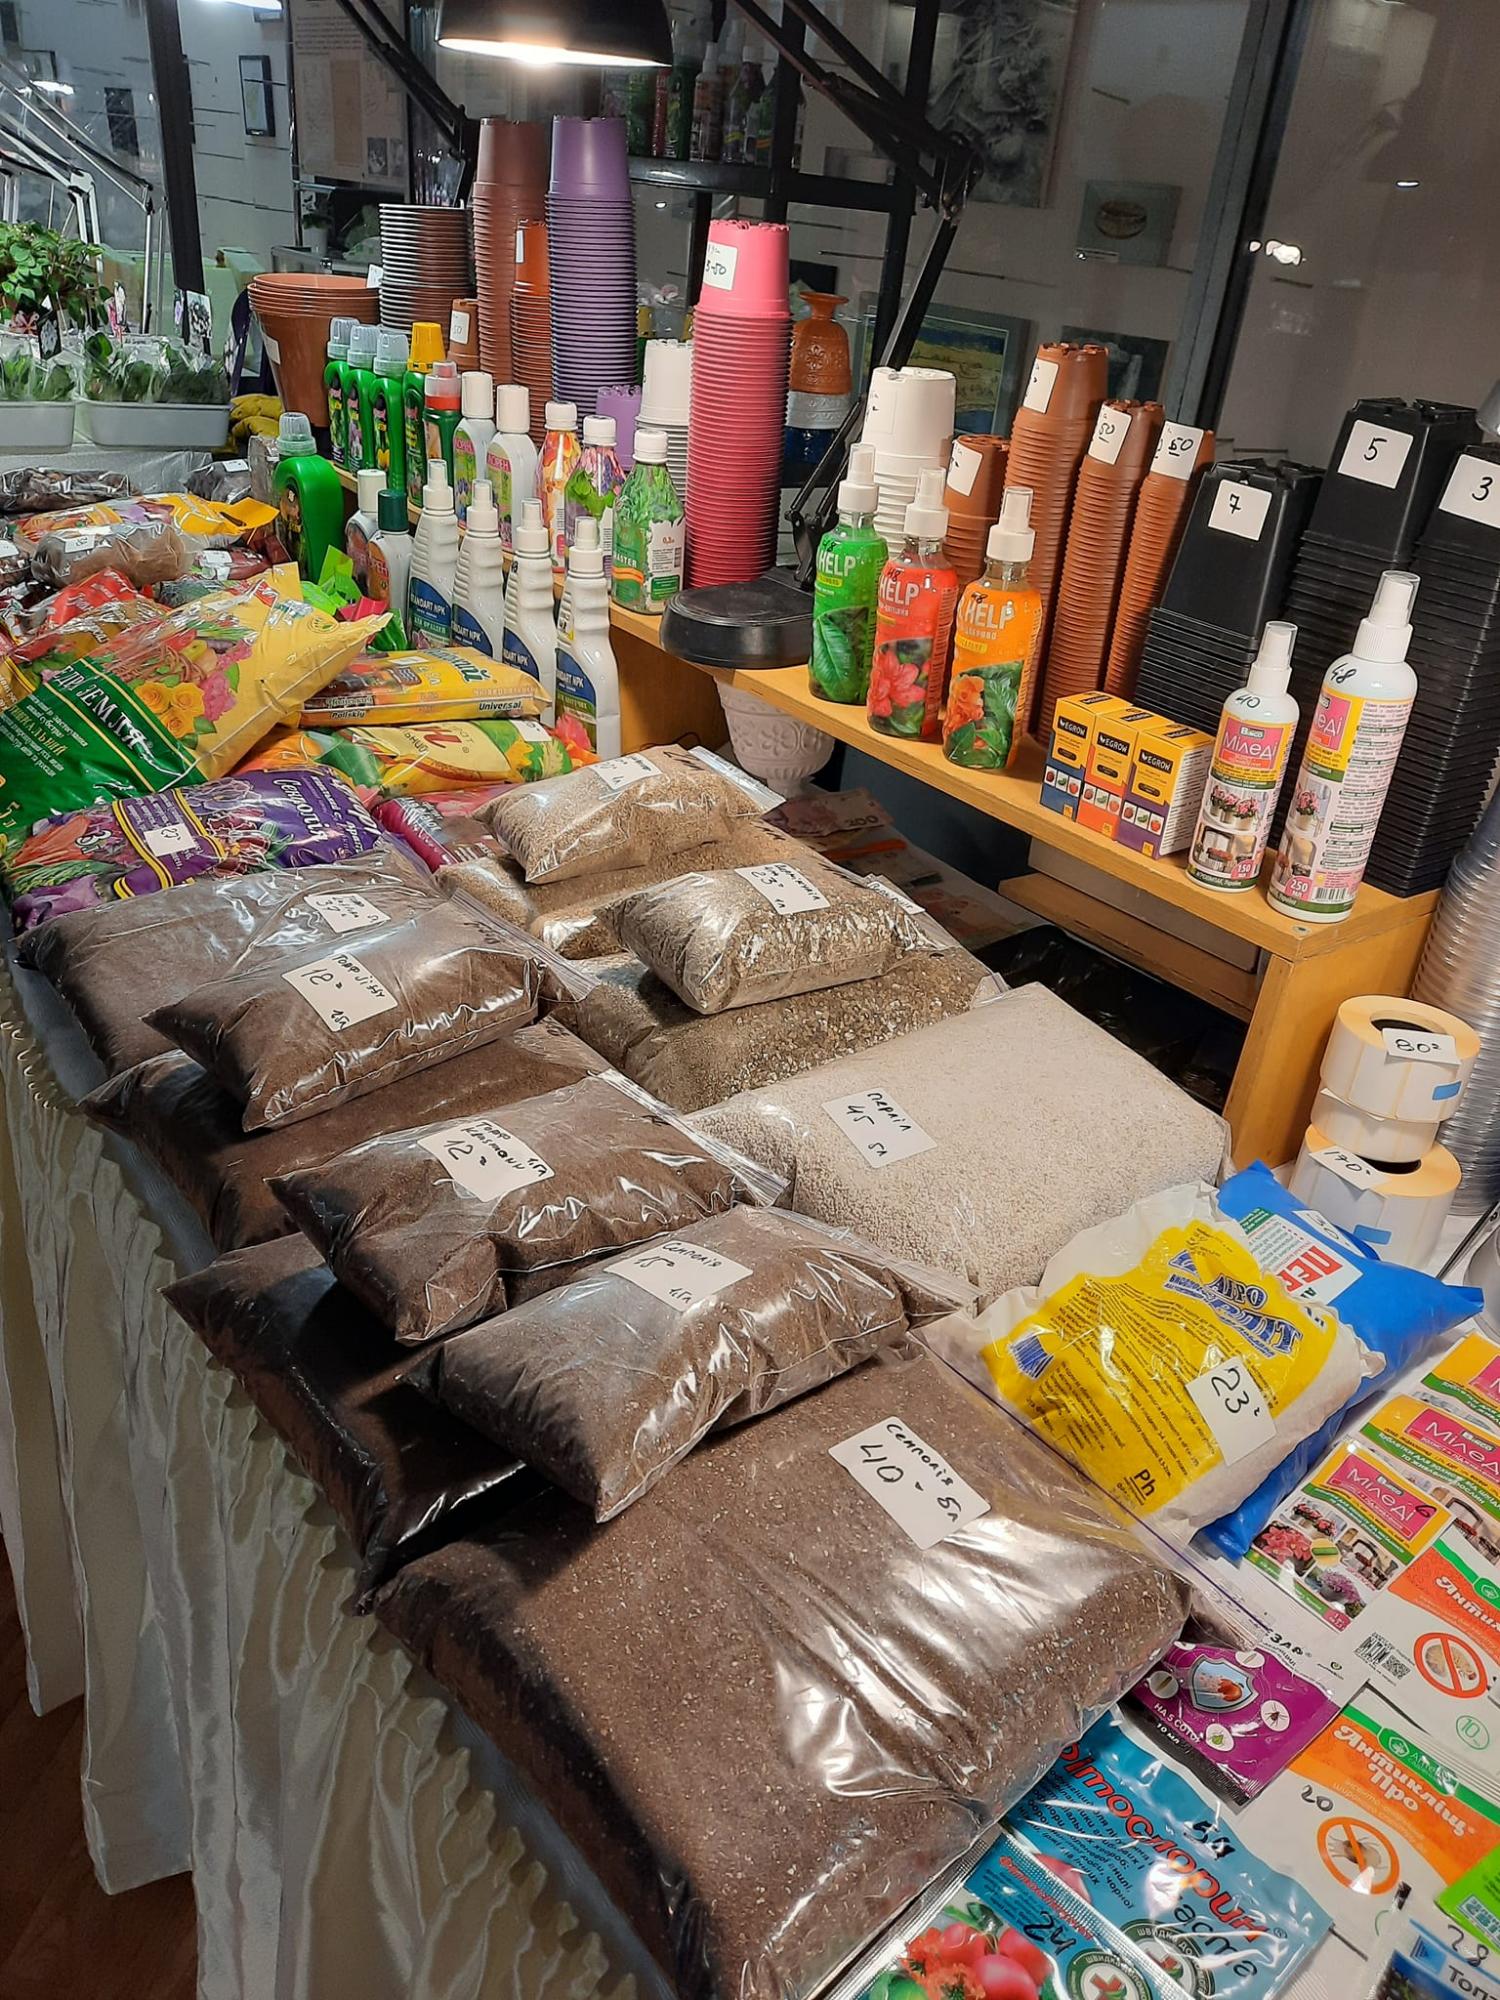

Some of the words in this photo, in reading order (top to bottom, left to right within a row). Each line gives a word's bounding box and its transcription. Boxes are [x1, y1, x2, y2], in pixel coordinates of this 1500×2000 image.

[1363, 437, 1388, 461] 5
[1471, 476, 1494, 501] 3
[1227, 493, 1242, 515] 7
[817, 550, 857, 577] HELP
[880, 574, 920, 606] HELP
[965, 600, 1016, 630] HELP
[478, 700, 522, 712] Universal
[1059, 718, 1087, 736] WEGROW
[1317, 712, 1344, 737] еді
[1099, 734, 1129, 752] WEGROW
[1141, 750, 1172, 771] WEGROW
[1290, 879, 1309, 894] 250
[1276, 1245, 1344, 1293] ПЕР
[1210, 1366, 1250, 1414] 23
[1134, 1468, 1158, 1498] Ph
[1153, 1702, 1169, 1718] НА
[1156, 1722, 1168, 1735] 10
[1167, 1733, 1180, 1745] мл
[1333, 1724, 1467, 1837] Антикліщ
[1367, 1762, 1420, 1812] Про
[1300, 1784, 1335, 1812] 20
[1173, 1893, 1259, 1979] аста
